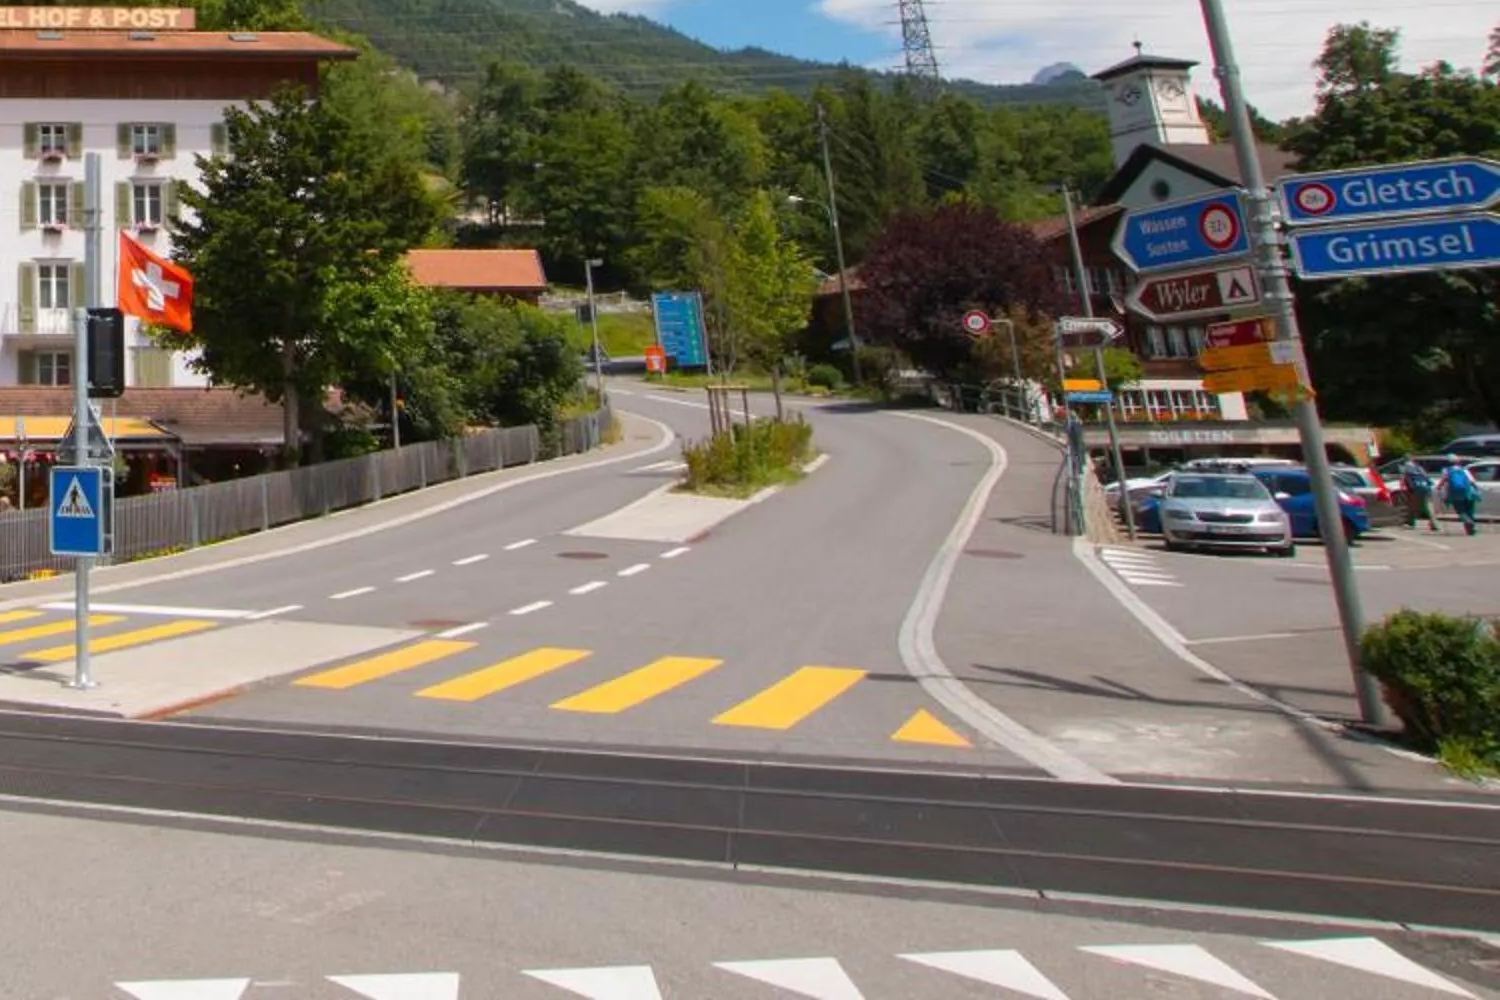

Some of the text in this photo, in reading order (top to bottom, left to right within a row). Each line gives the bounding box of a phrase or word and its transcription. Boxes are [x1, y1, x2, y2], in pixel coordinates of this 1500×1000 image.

[29, 7, 80, 28] HOF
[88, 8, 106, 28] &
[113, 8, 181, 28] POST
[1342, 168, 1476, 207] Gletsch
[1138, 215, 1187, 236] Wassen
[1327, 223, 1475, 264] Grimsel
[1155, 279, 1212, 312] Wyler
